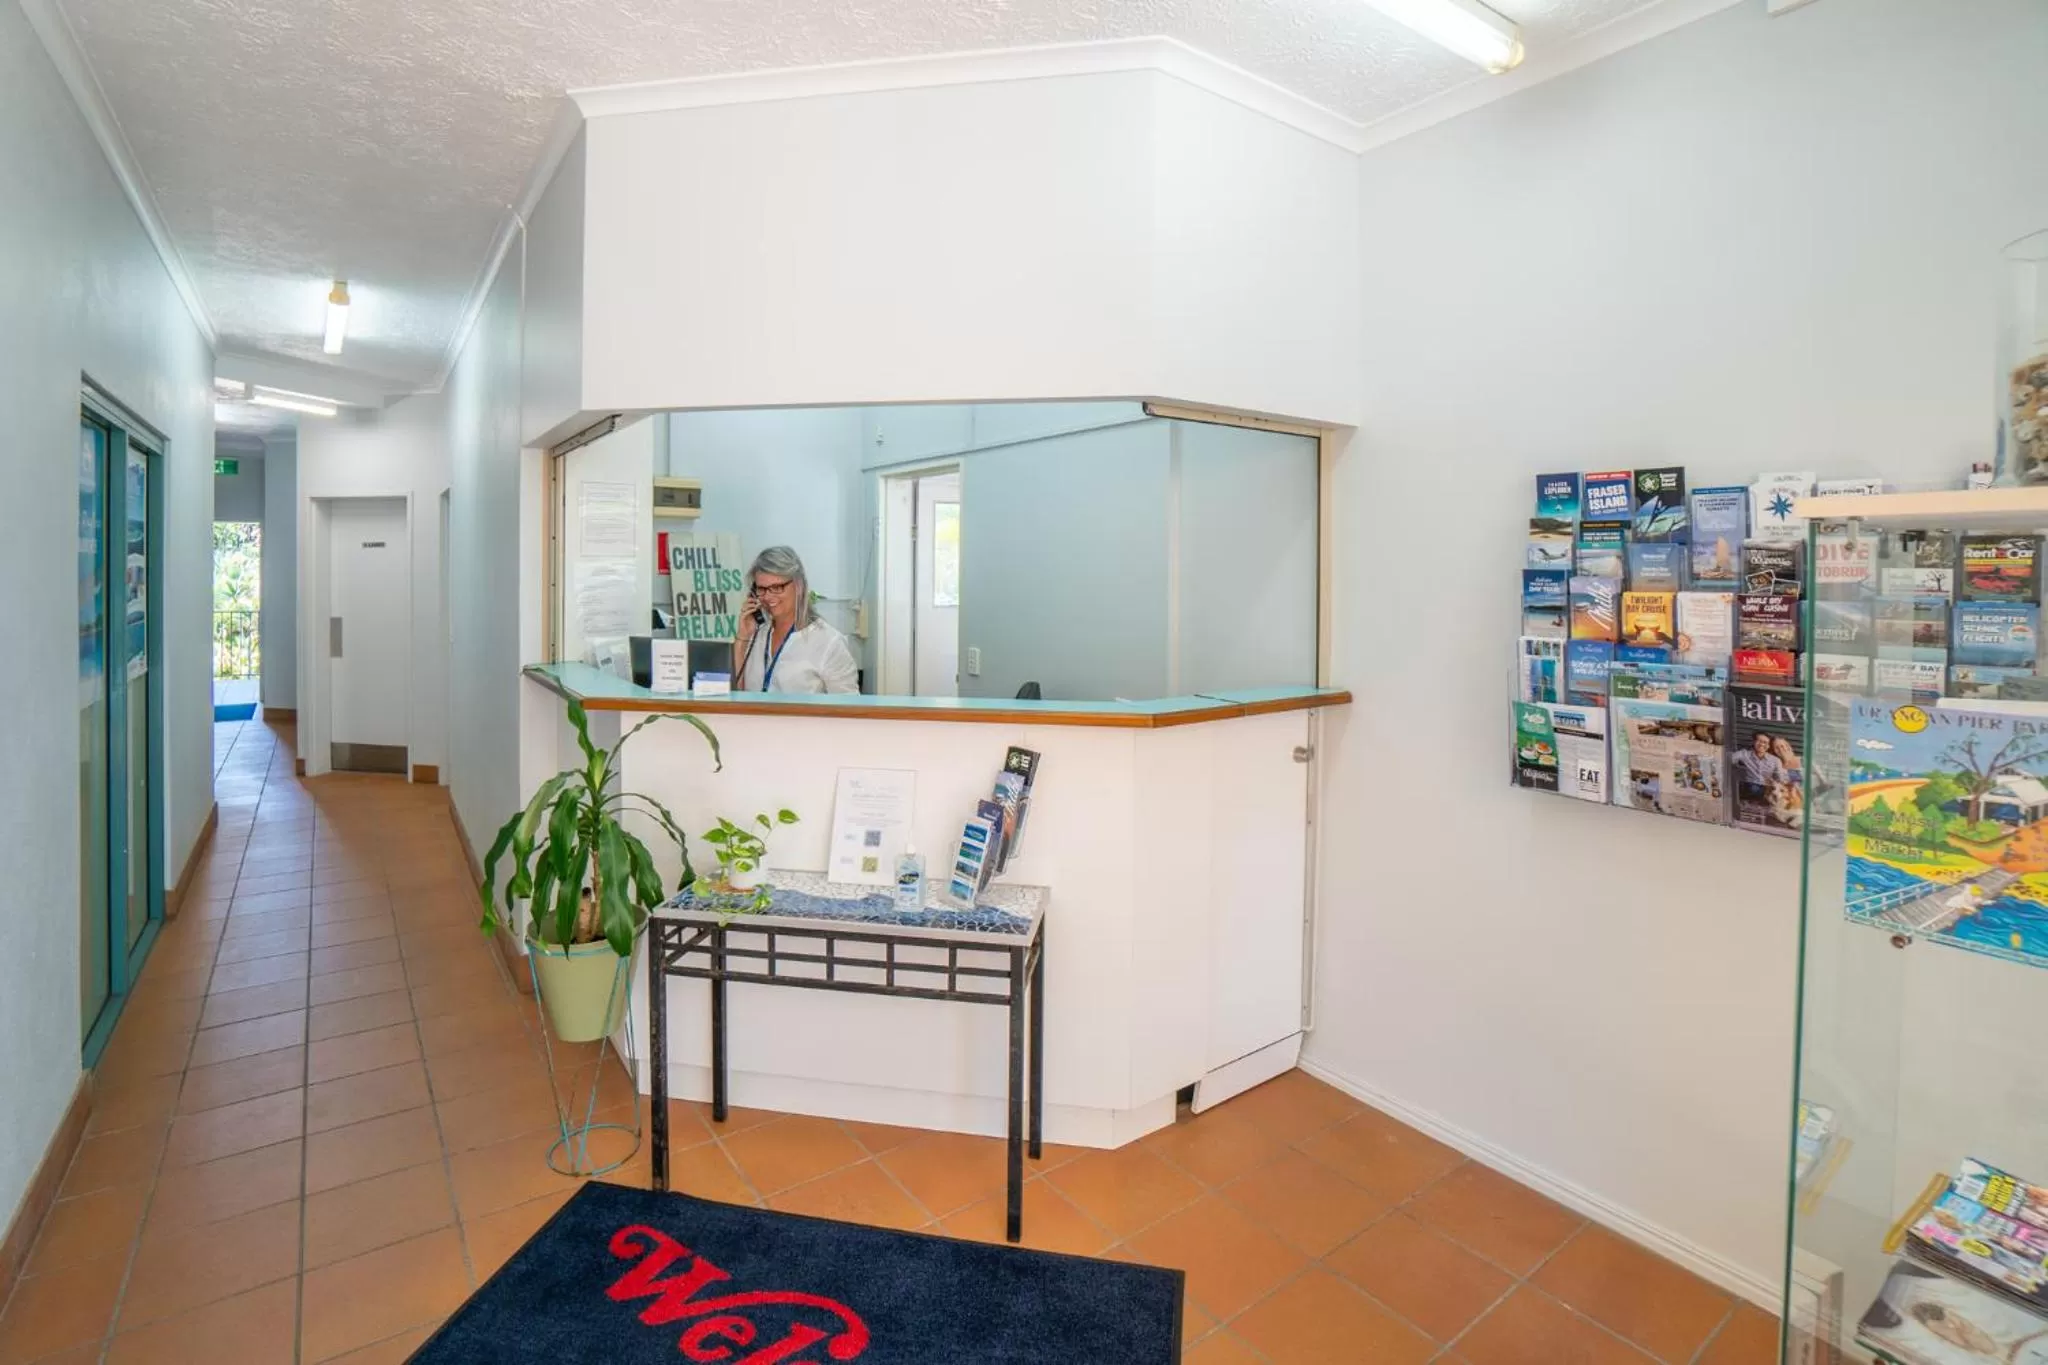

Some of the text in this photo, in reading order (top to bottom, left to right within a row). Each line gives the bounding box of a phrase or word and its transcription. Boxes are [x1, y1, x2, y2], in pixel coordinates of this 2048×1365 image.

[1587, 484, 1626, 499] FRASER
[1589, 496, 1628, 510] ISLAND
[672, 547, 721, 570] CHILL
[1817, 566, 1870, 578] TOBRUK
[693, 569, 743, 592] BLISS
[676, 593, 727, 616] CALM
[1631, 596, 1663, 604] TWILIGHT
[1642, 604, 1666, 613] CRUISE
[1962, 615, 2028, 623] HELICOPTER
[679, 615, 737, 639] RELAX
[1963, 624, 2001, 633] SCENIC
[1962, 634, 2005, 644] FLIGHTS
[1956, 715, 2004, 731] PIER
[1579, 768, 1600, 784] EAT
[604, 1224, 871, 1365] Wel
